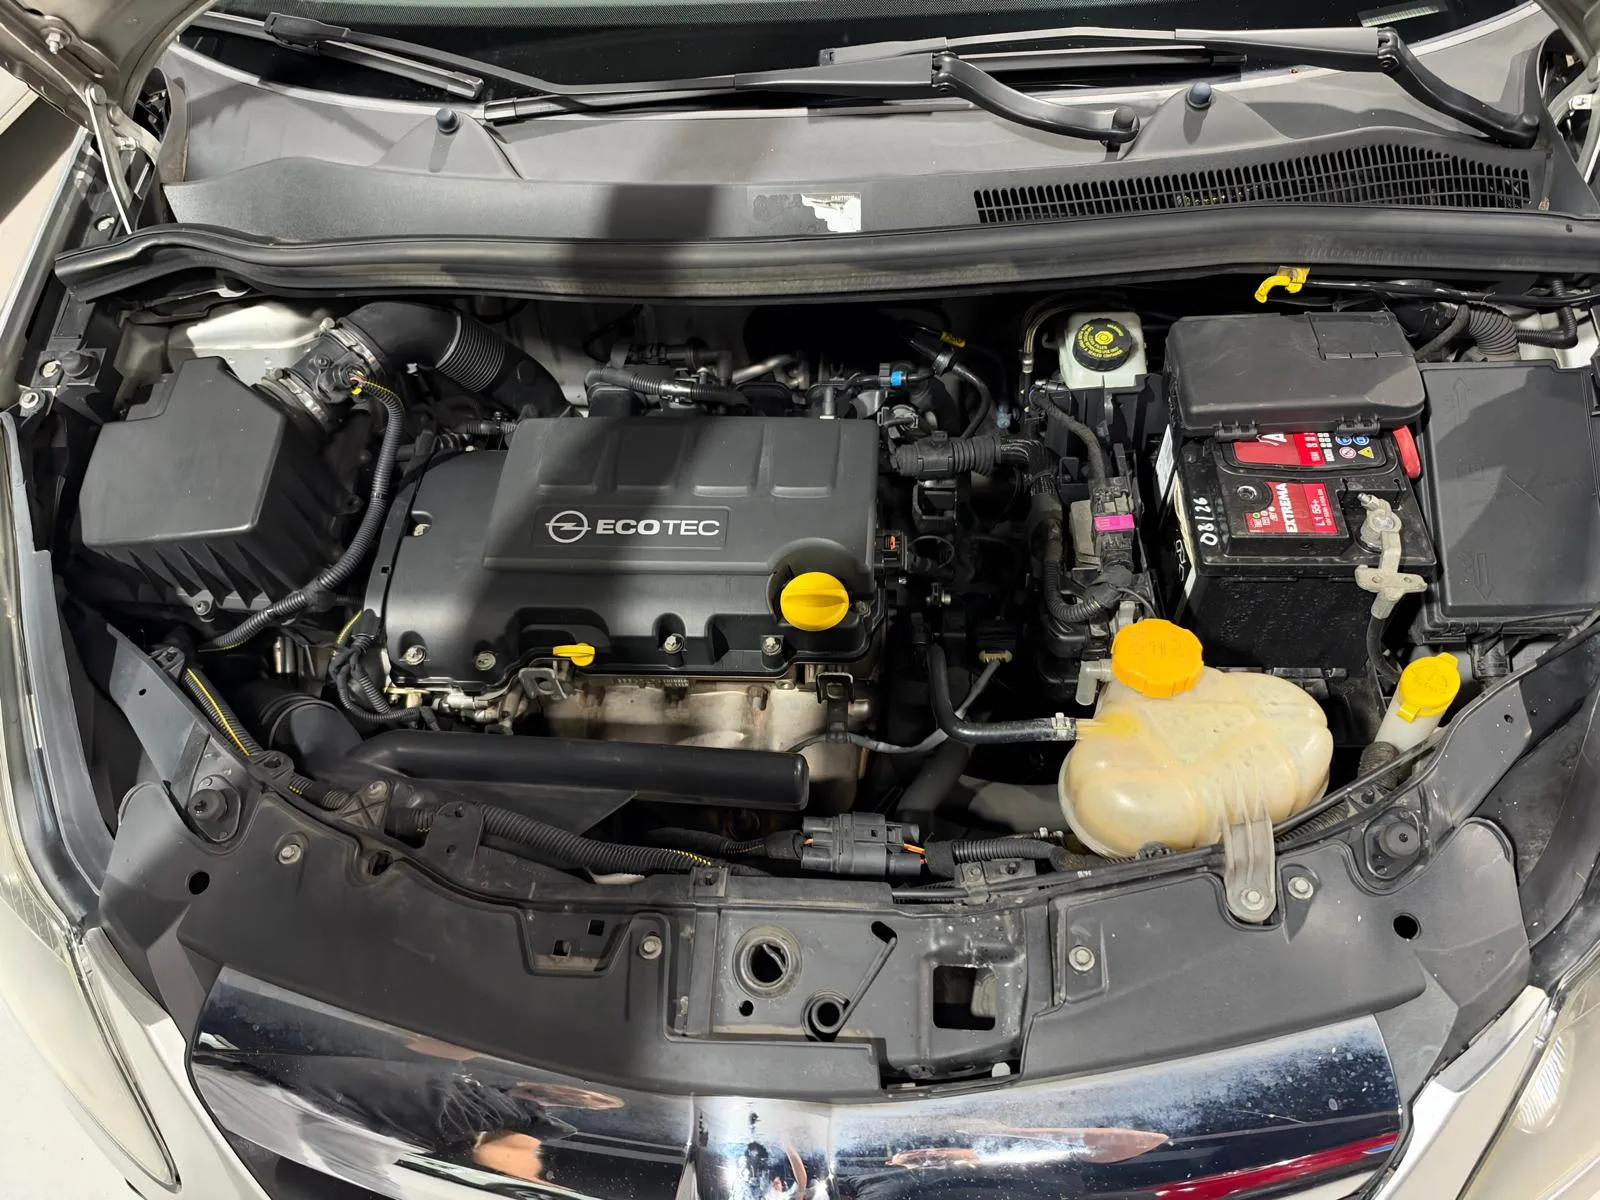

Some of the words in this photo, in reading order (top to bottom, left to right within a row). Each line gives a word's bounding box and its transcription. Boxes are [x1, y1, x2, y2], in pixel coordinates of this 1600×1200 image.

[596, 519, 720, 537] ECOTEC
[1193, 497, 1219, 546] 08/26
[1276, 483, 1298, 533] EXTREMA
